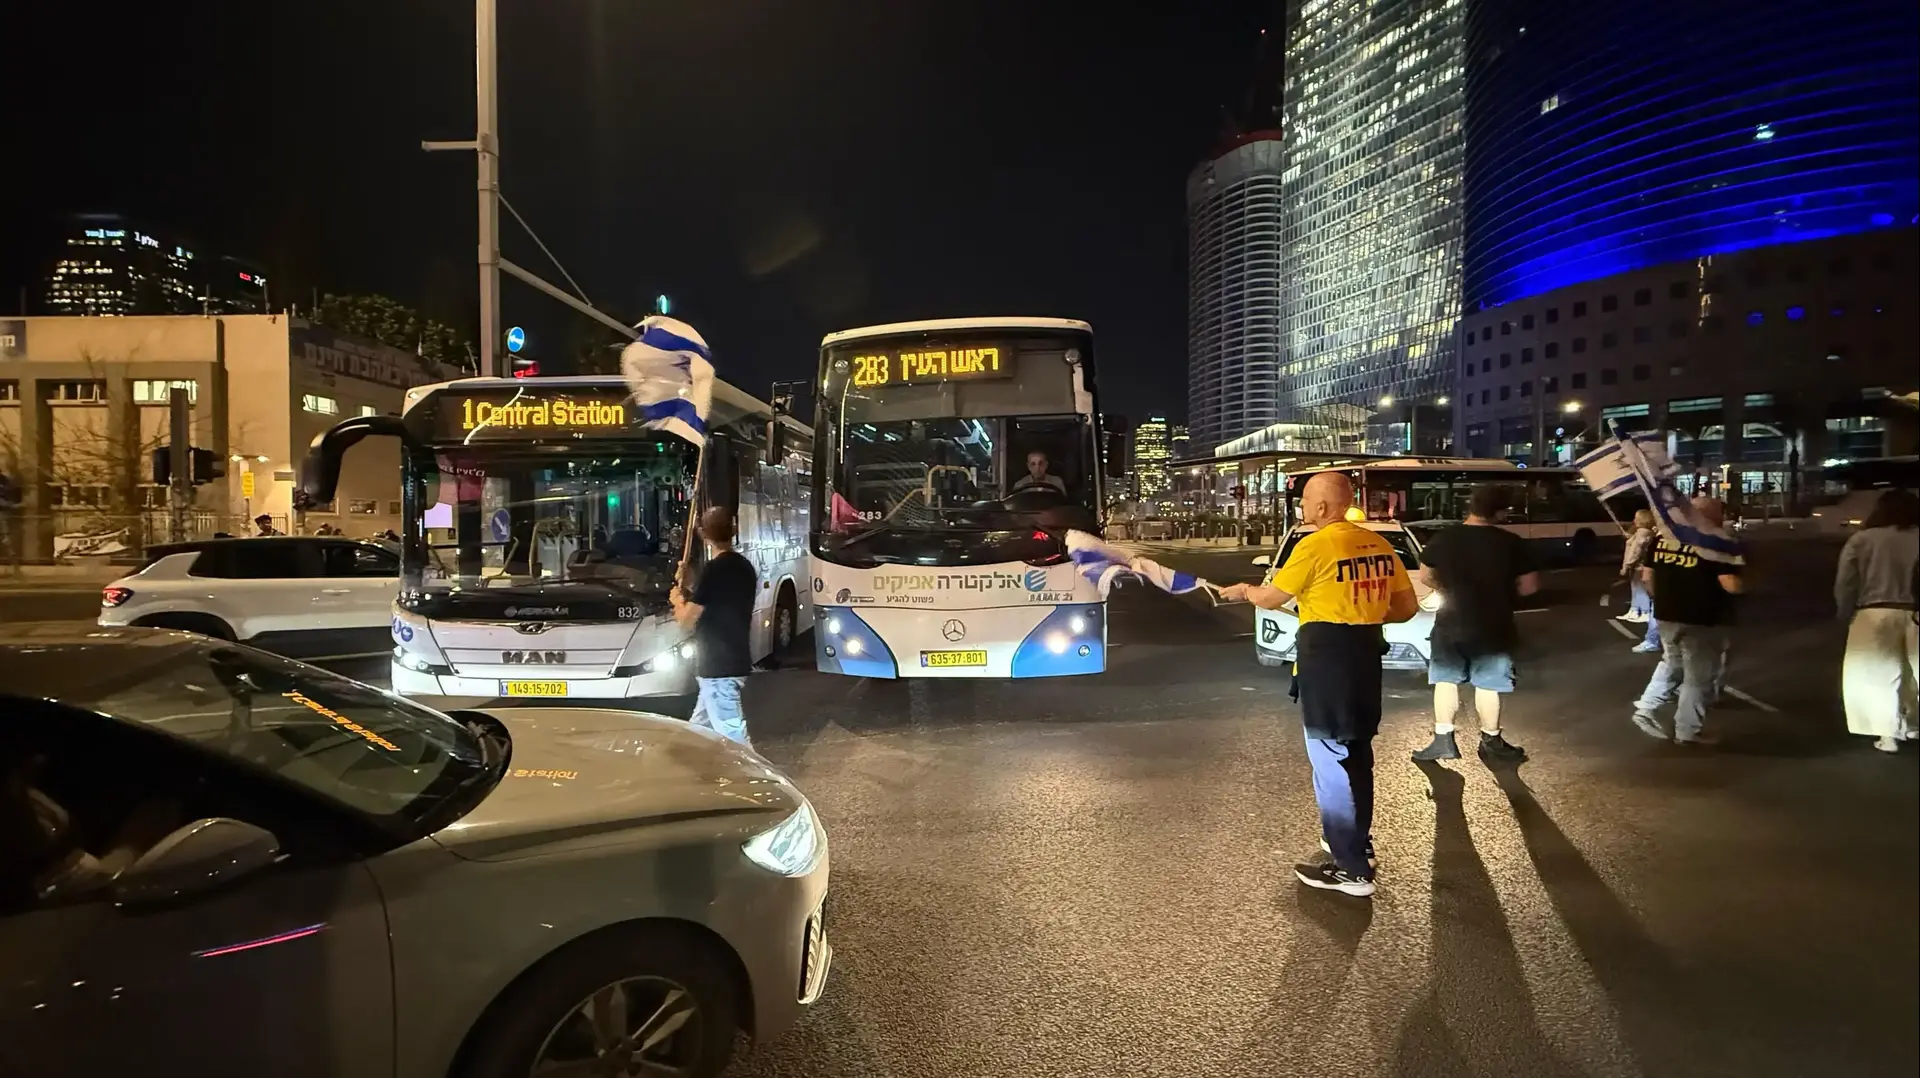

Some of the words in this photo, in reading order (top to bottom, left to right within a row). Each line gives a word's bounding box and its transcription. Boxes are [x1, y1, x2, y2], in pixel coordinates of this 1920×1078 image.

[854, 355, 889, 386] 283
[900, 351, 947, 380] העין
[950, 348, 999, 373] ראש
[462, 398, 474, 429] 1
[476, 401, 549, 426] Central
[552, 401, 624, 425] Station
[858, 511, 882, 520] 283
[873, 574, 934, 594] אפיקים
[937, 571, 1021, 593] אלקטרה
[617, 607, 640, 618] 832
[501, 650, 567, 664] MAN
